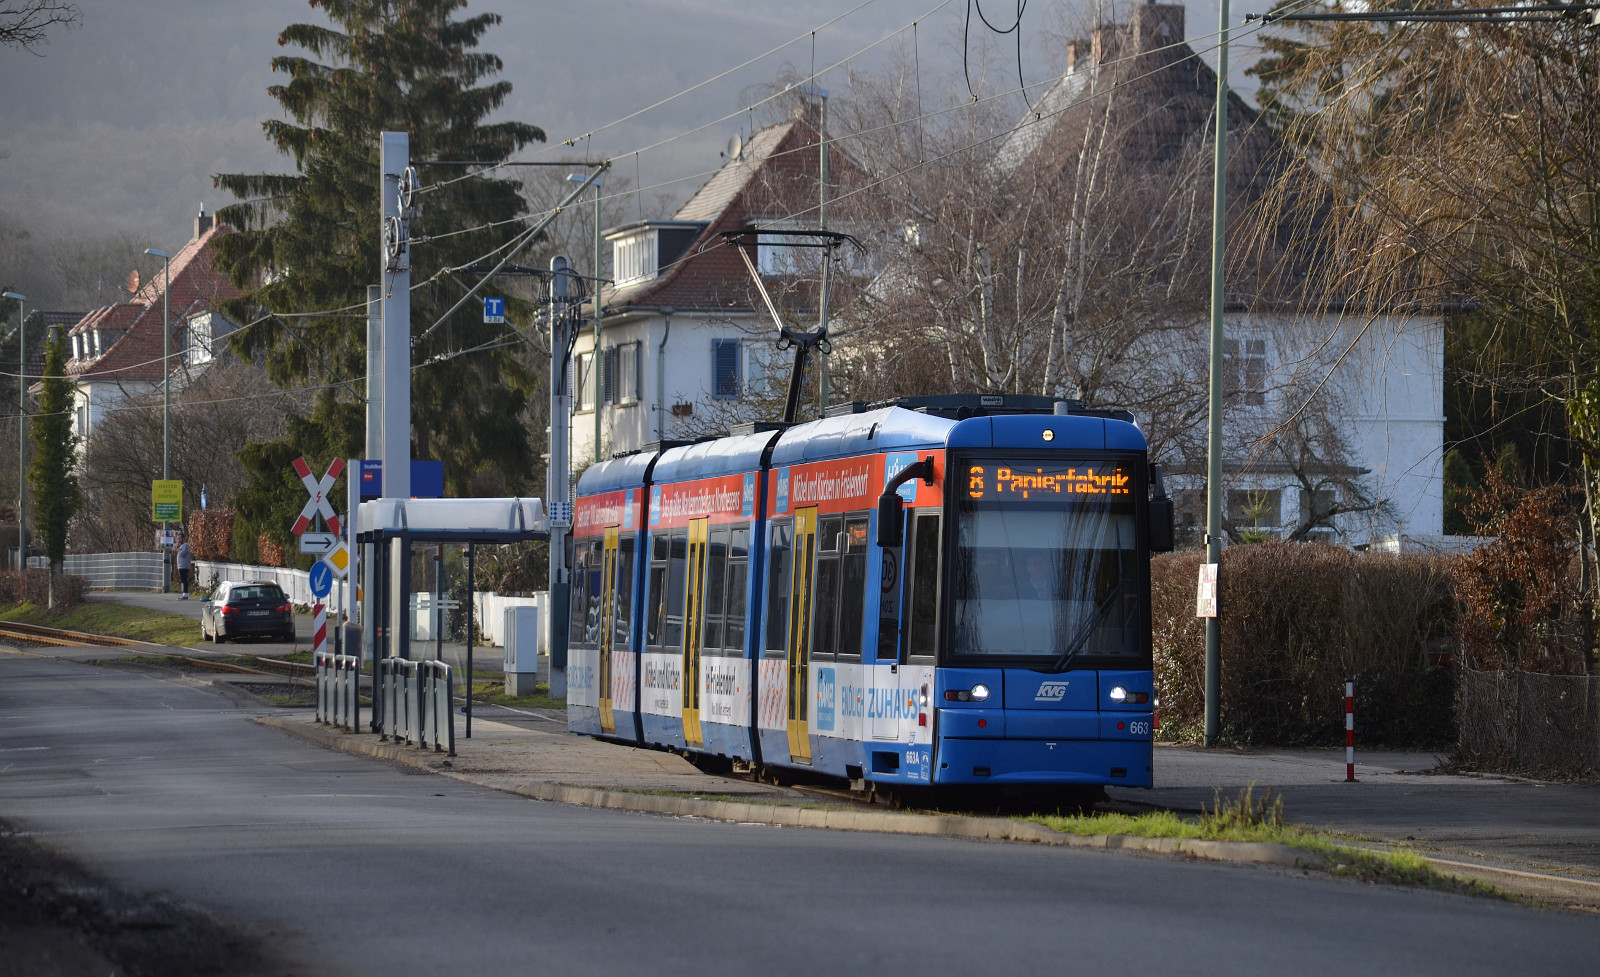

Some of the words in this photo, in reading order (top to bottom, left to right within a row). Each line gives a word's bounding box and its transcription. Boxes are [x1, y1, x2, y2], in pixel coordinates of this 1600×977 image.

[488, 299, 501, 315] T
[997, 467, 1129, 499] Papierfabrik
[1036, 685, 1067, 697] KVG
[841, 685, 865, 718] ENDLICH
[1130, 721, 1149, 735] 663
[905, 750, 920, 765] 663A
